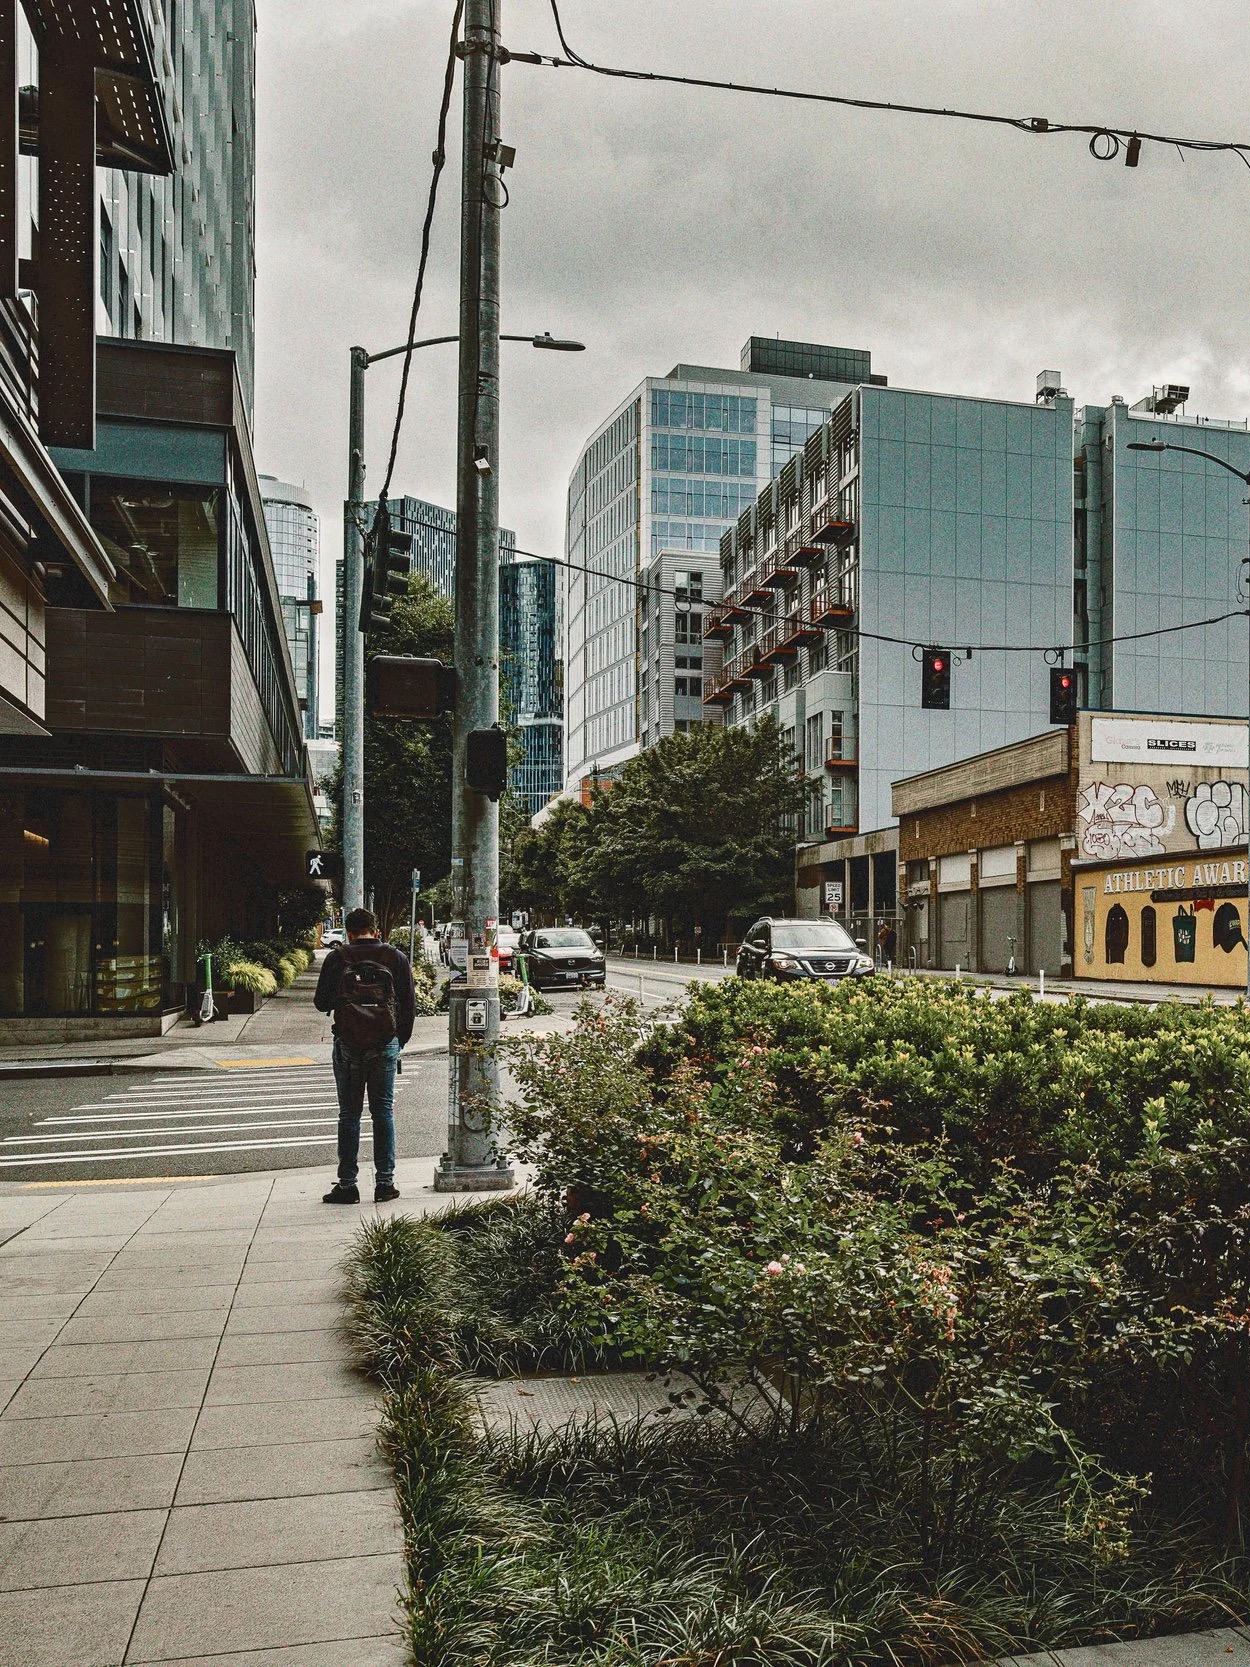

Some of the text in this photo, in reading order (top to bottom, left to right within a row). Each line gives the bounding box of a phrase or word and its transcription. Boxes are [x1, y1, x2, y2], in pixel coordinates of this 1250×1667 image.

[1147, 739, 1196, 749] SLICES
[1103, 866, 1185, 894] ATHLETIC
[827, 893, 841, 901] 25
